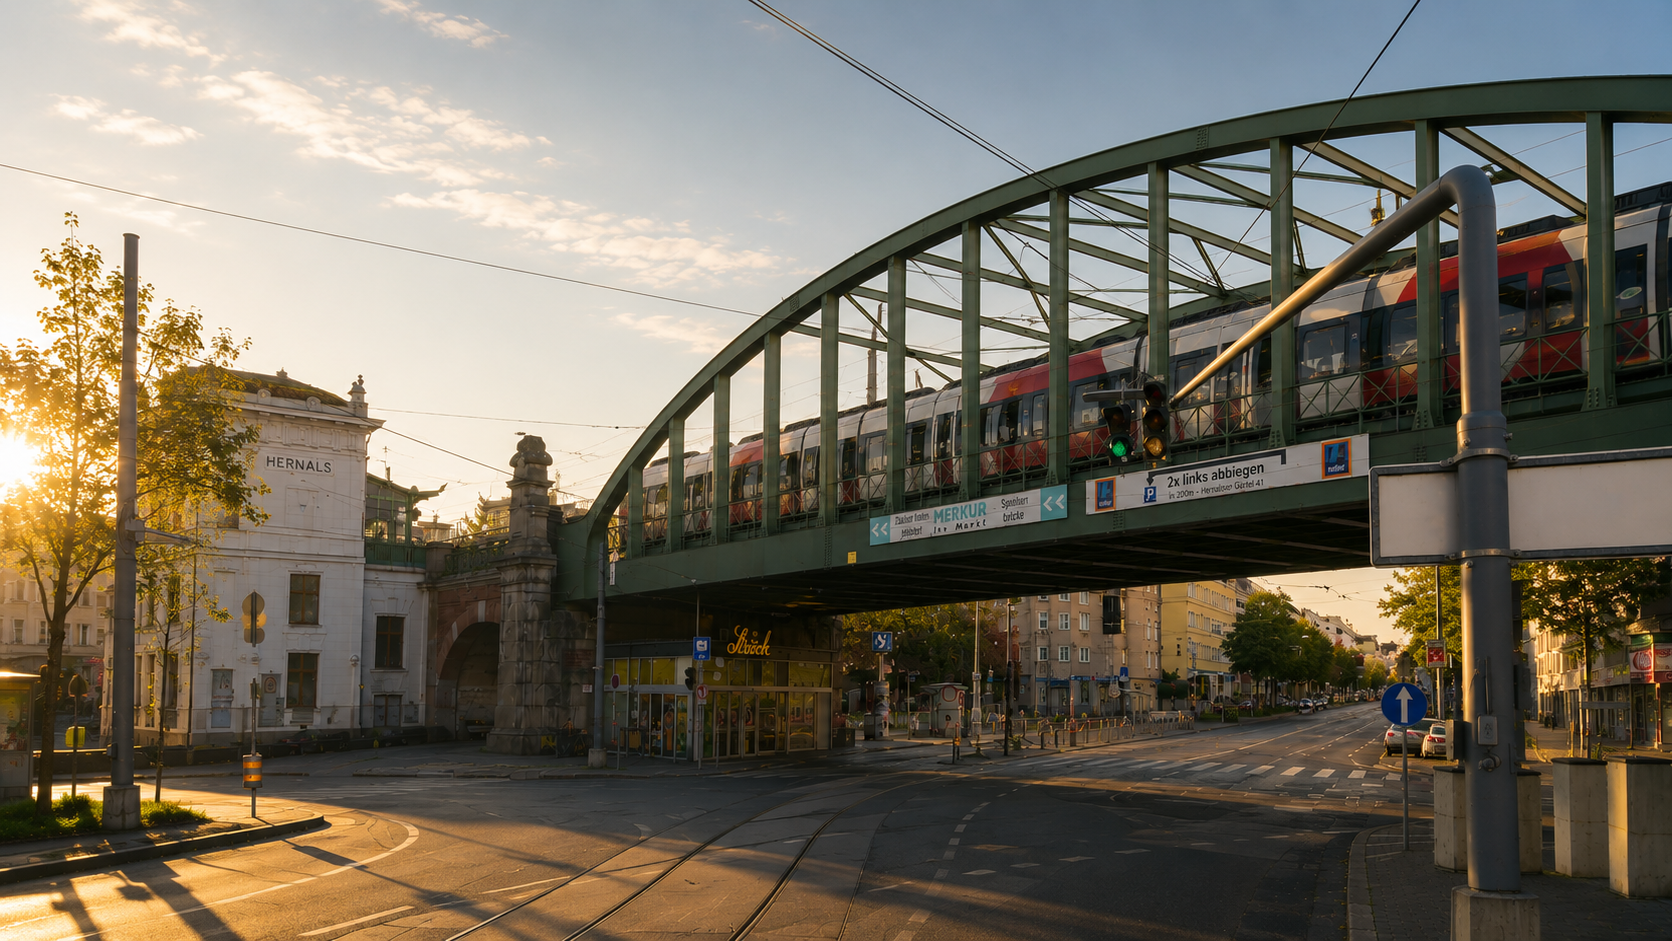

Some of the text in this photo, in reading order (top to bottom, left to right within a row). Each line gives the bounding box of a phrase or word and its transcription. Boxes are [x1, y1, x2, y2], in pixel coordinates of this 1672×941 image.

[266, 455, 332, 473] HERNALS
[1167, 463, 1264, 488] 2x links abbiegen
[933, 501, 987, 524] MERKUR
